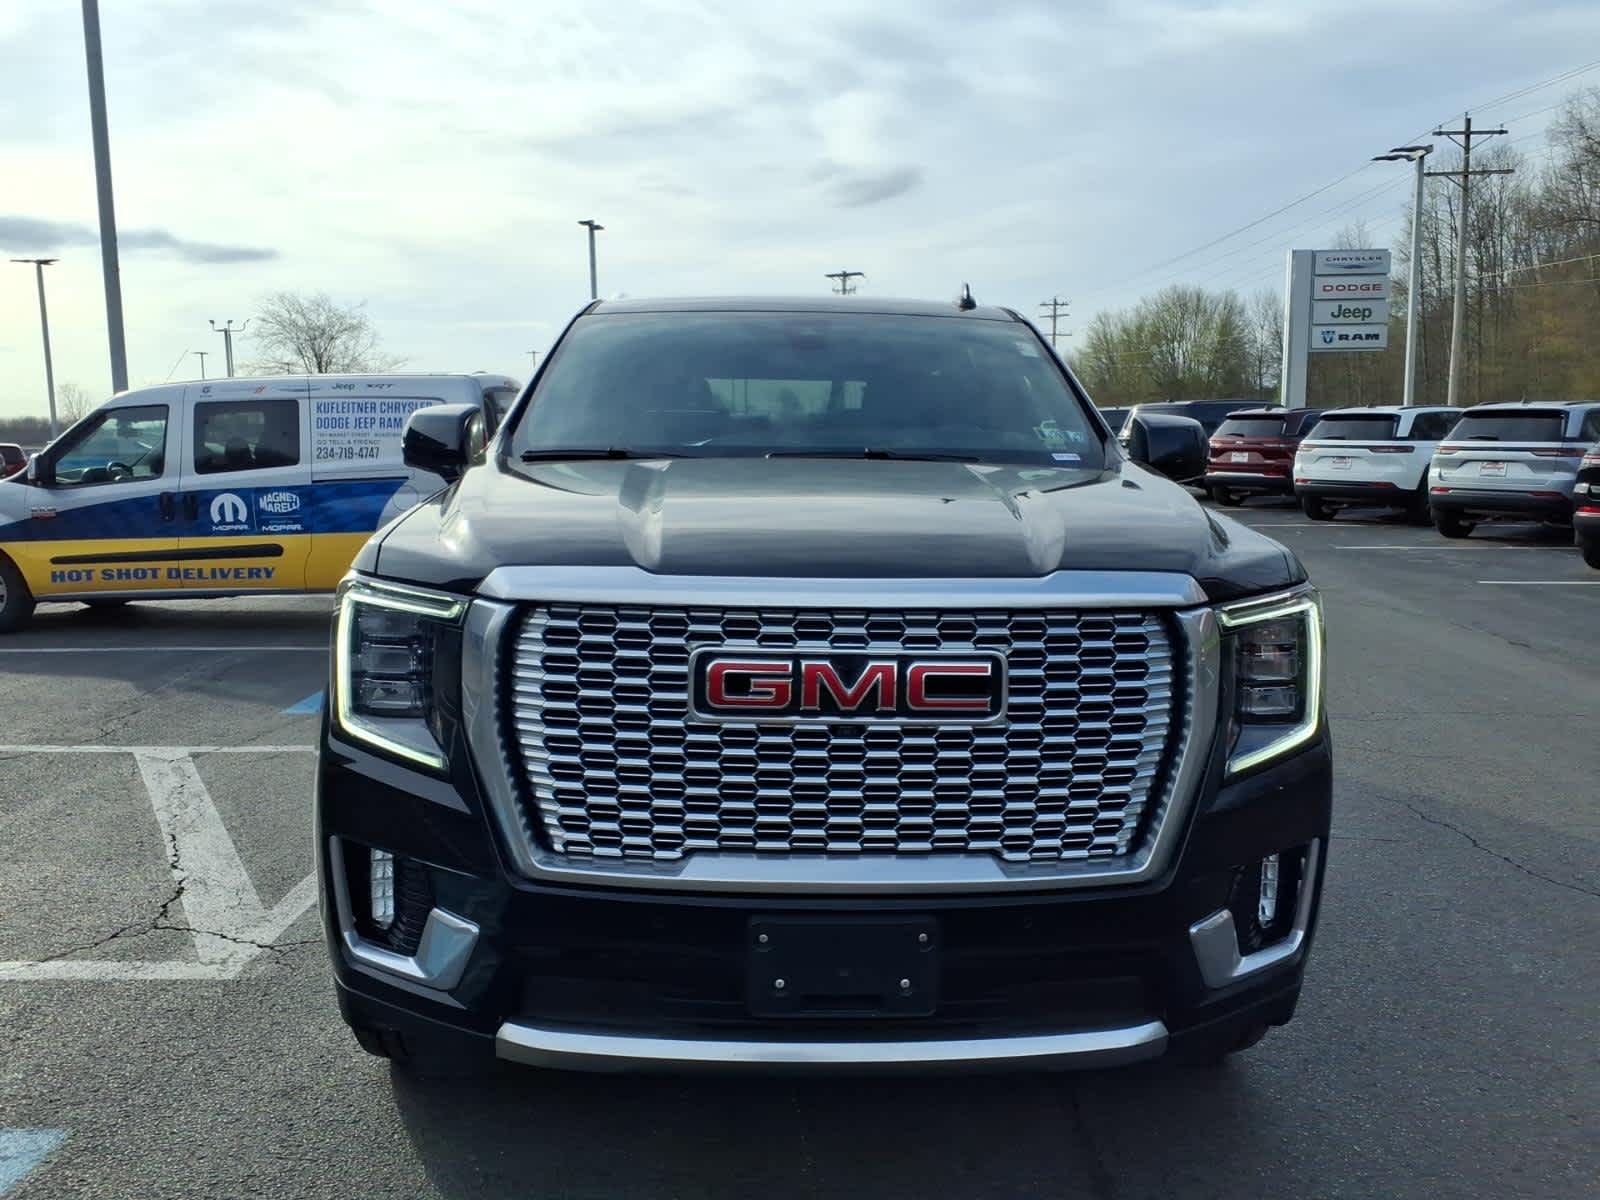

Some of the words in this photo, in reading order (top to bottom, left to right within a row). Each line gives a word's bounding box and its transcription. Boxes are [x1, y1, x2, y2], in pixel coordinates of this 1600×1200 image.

[1322, 283, 1383, 292] DODGE
[1331, 304, 1372, 321] Jeep
[1338, 333, 1380, 341] RAM
[331, 383, 356, 391] Jeep
[316, 401, 377, 414] KUFLEITNER
[316, 417, 350, 430] DODGE
[353, 417, 376, 430] JEEP
[379, 417, 402, 429] RAM
[316, 447, 379, 460] 234-719-4747
[51, 569, 95, 582] HOT
[101, 567, 161, 581] SHOT
[167, 566, 275, 580] DELIVERY
[706, 658, 992, 712] GMC
